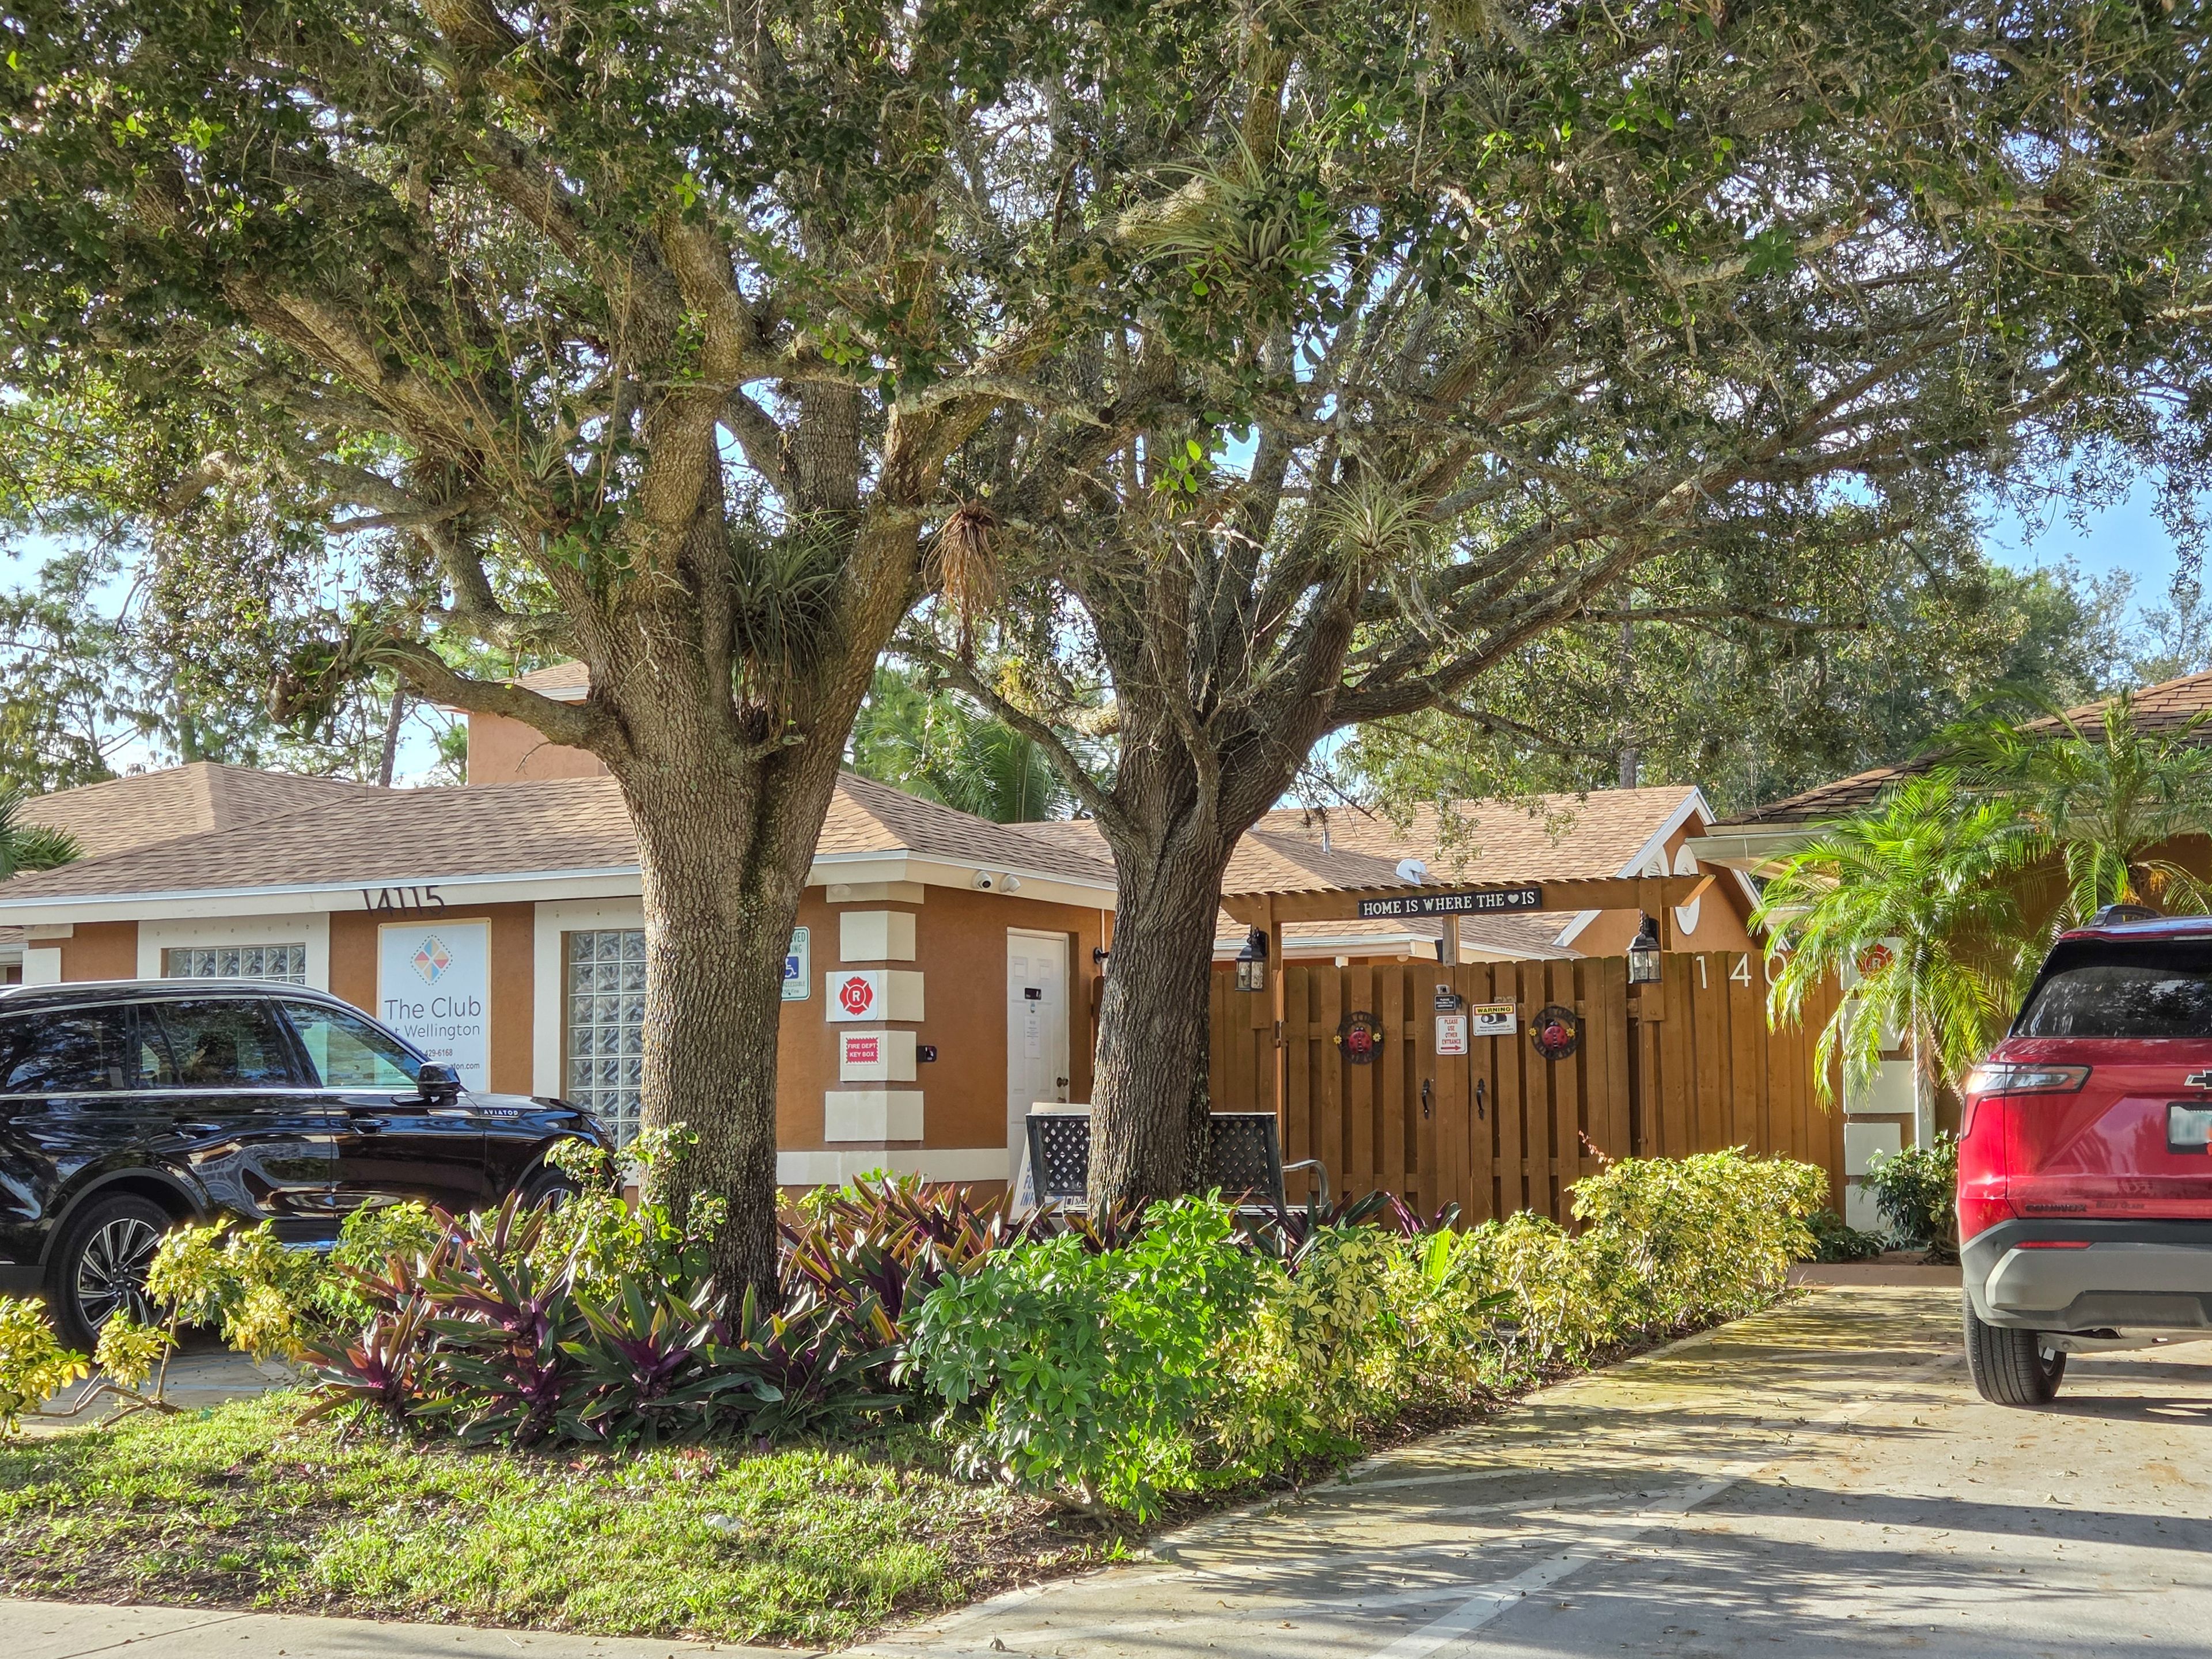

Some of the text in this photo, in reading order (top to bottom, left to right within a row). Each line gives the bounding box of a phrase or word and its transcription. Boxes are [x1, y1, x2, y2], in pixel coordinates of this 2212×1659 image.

[358, 885, 445, 916] 14115
[1363, 891, 1536, 916] HOME IS WHERE THE IS
[791, 932, 806, 943] VED
[853, 990, 860, 1002] R
[384, 995, 481, 1020] The Club
[404, 1023, 480, 1040] Wellington
